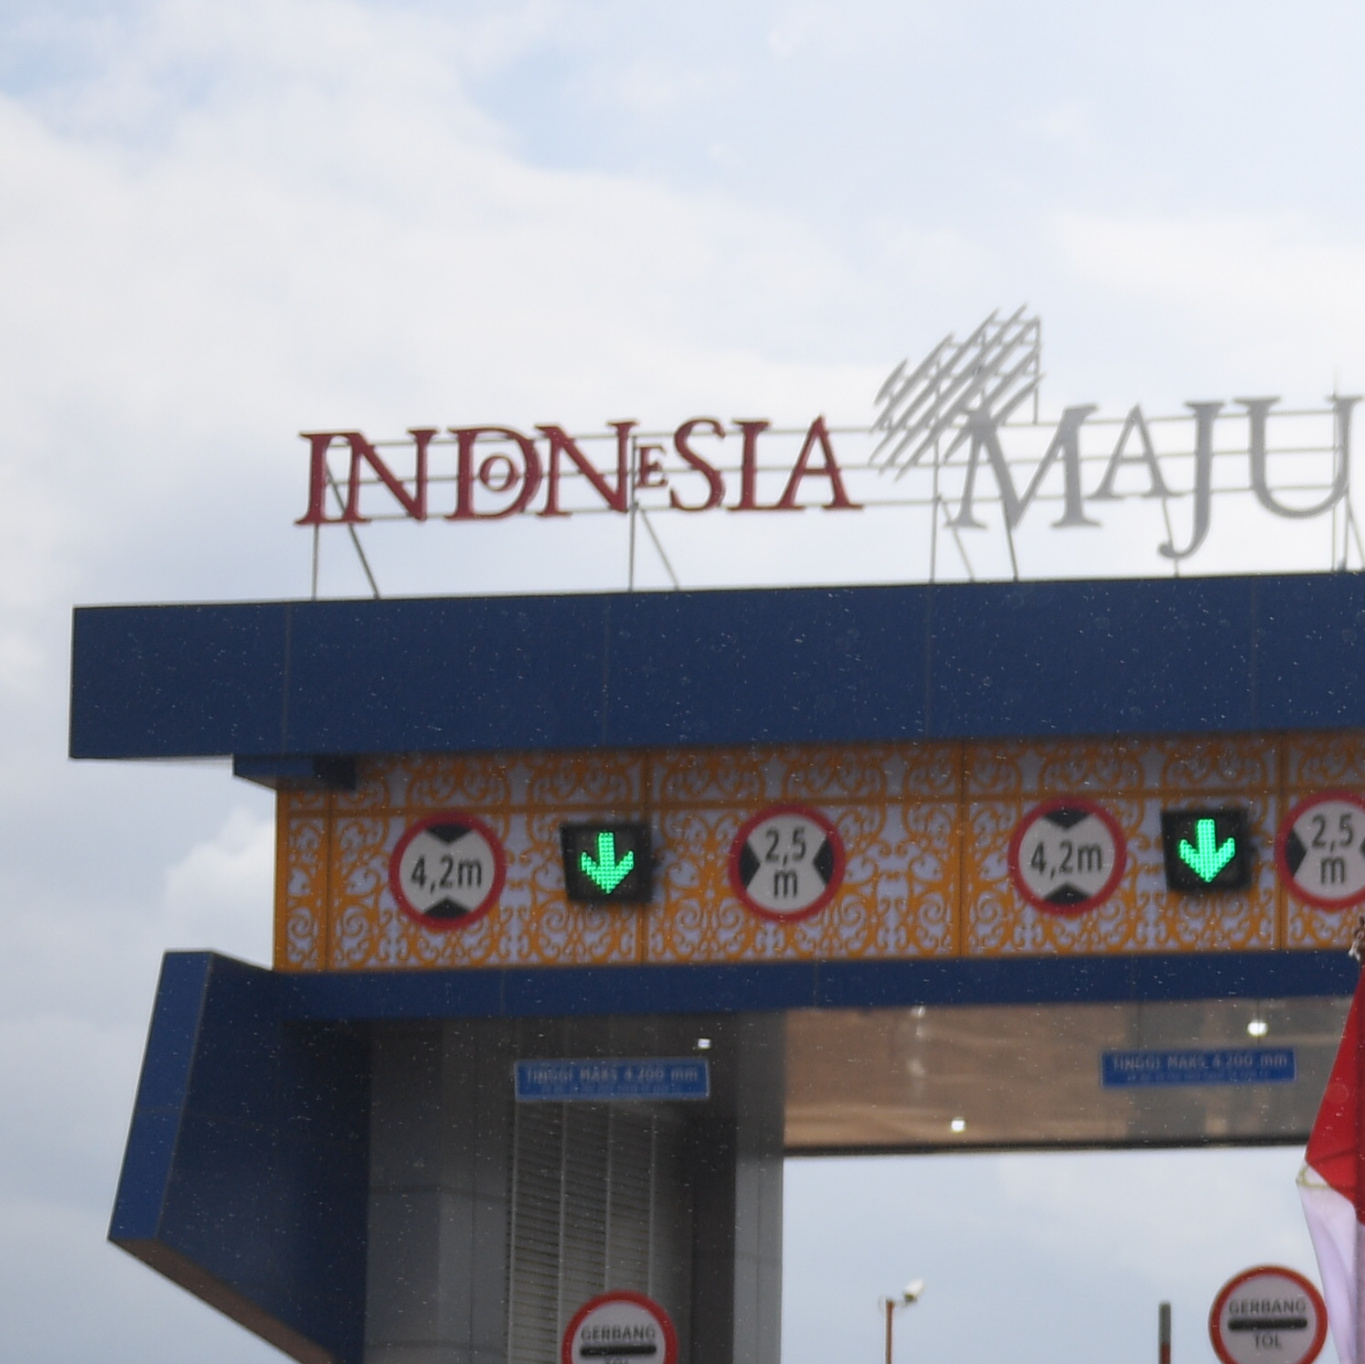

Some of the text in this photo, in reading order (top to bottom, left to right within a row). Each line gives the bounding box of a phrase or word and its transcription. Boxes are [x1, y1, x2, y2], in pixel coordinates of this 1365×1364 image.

[293, 396, 1365, 559] INDONESIA MAJU
[766, 827, 807, 866] 2,5
[1311, 813, 1355, 852] 2,5
[773, 870, 799, 899] m
[1320, 857, 1346, 885] m
[1229, 1300, 1306, 1314] GERBANG
[580, 1325, 657, 1340] GERBANG
[1254, 1333, 1283, 1349] TOL
